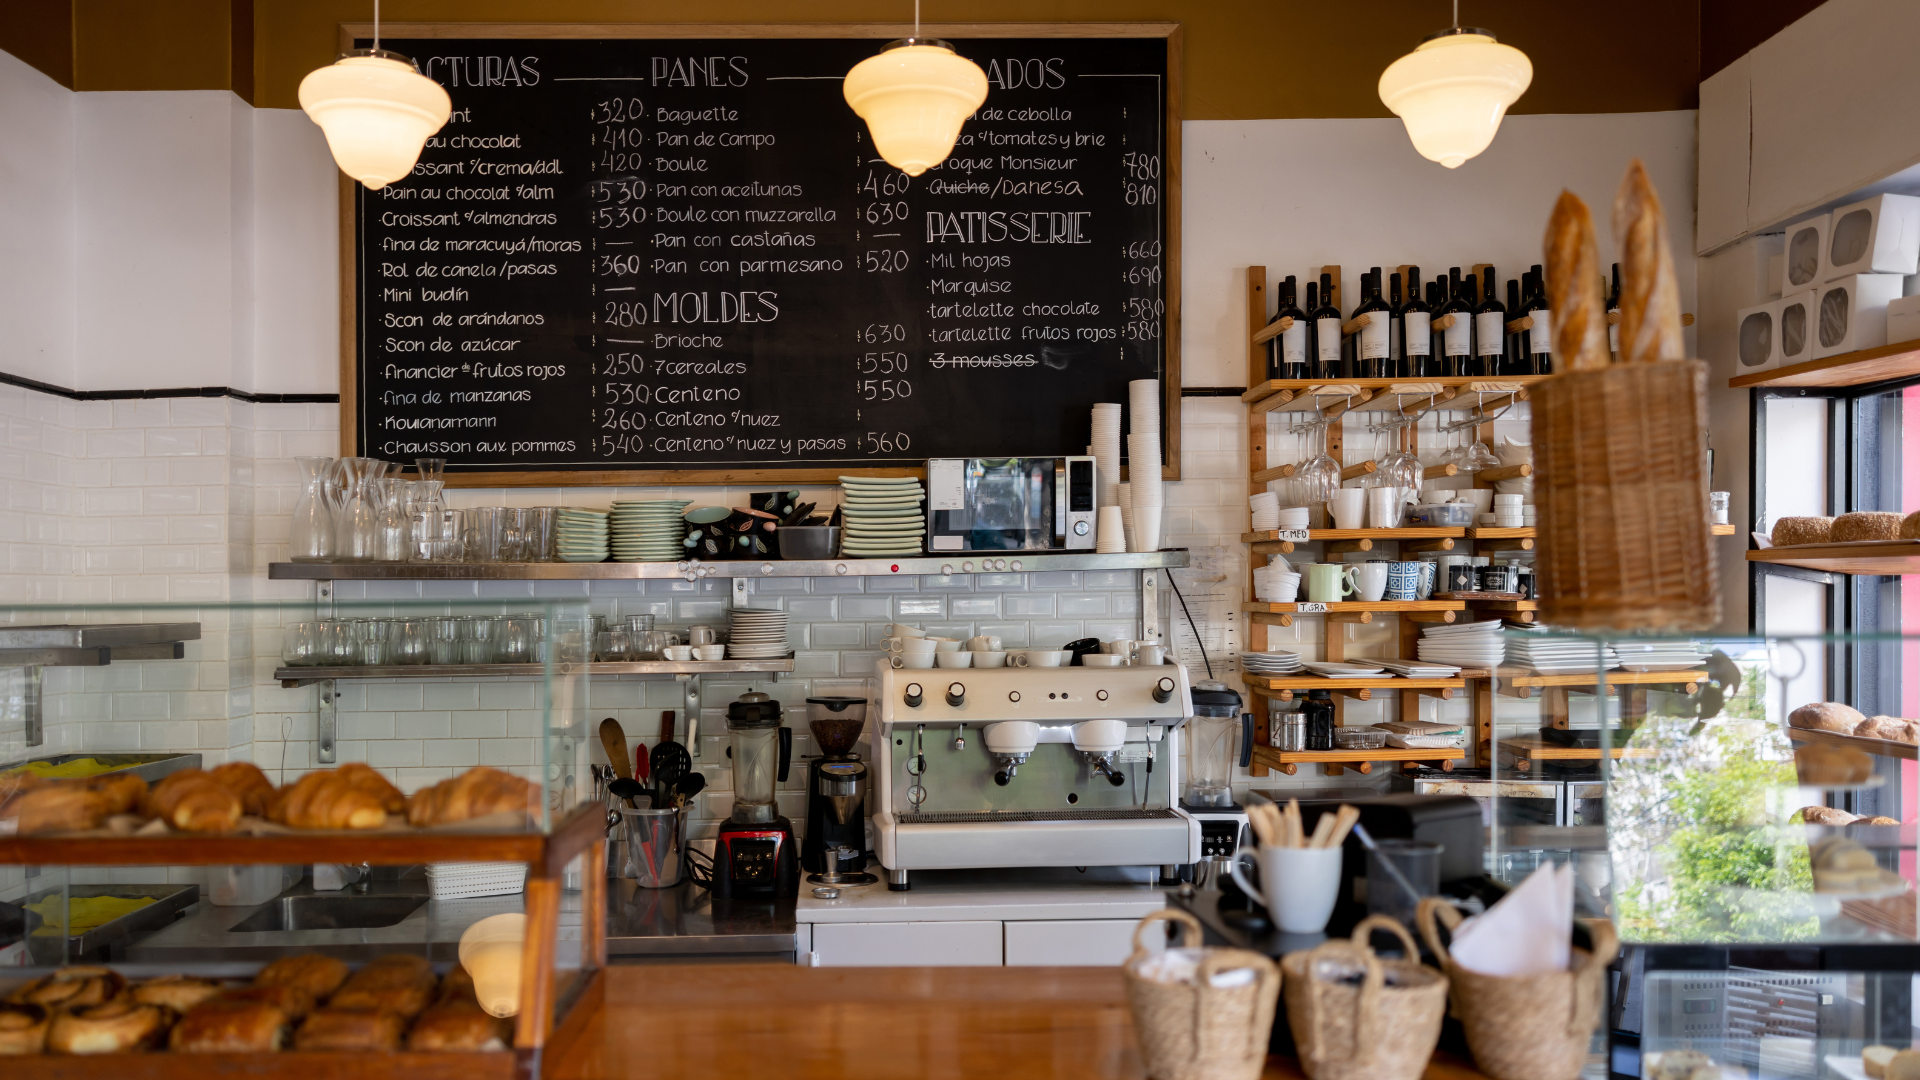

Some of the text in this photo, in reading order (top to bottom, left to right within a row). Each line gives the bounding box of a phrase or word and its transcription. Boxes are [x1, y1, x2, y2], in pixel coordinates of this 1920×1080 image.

[653, 57, 748, 86] PANES
[658, 106, 738, 125] Baguette
[983, 107, 1003, 120] de
[1008, 107, 1071, 121] cebolla
[451, 135, 521, 148] chocolat
[657, 132, 774, 150] Pan de Campo
[1076, 132, 1105, 146] brie
[656, 157, 708, 171] Boule
[1001, 156, 1077, 170] Monsieur
[383, 187, 417, 200] Pain
[421, 189, 440, 199] au
[446, 186, 509, 200] chocolat
[657, 184, 686, 197] Pan
[691, 186, 716, 196] con
[722, 181, 802, 196] aceitunas
[382, 212, 460, 226] Croissant
[657, 206, 707, 222] Boule
[711, 211, 739, 221] con
[746, 207, 835, 222] muzzarella
[927, 212, 1091, 243] PATISSERIE
[383, 237, 415, 251] fina
[420, 237, 439, 251] de
[655, 231, 815, 247] Pan con castañas
[382, 263, 409, 277] Rol
[416, 262, 438, 277] de
[654, 259, 686, 273] Pan
[700, 261, 729, 272] con
[740, 260, 842, 276] parmesano
[932, 253, 1010, 272] Mil hojas
[385, 287, 468, 302] Mini budín
[932, 279, 1011, 297] Marquise
[653, 292, 778, 323] MOLDES
[930, 302, 1014, 318] tartelette
[1023, 301, 1099, 315] chocolate
[385, 313, 423, 327] Scon
[433, 312, 452, 326] de
[459, 312, 544, 325] arándanos
[655, 334, 723, 348] Brioche
[932, 327, 1011, 342] tartelette
[1022, 326, 1069, 339] frutos
[1077, 328, 1116, 342] rojos
[386, 337, 521, 352] Scon de azúcar
[473, 362, 523, 378] frutos
[527, 365, 565, 380] rojos
[384, 391, 416, 405] fina
[422, 390, 442, 404] de
[451, 390, 531, 403] manzanas
[655, 386, 740, 403] Centeno
[656, 411, 725, 426] Centeno
[385, 441, 470, 454] Chausson
[477, 442, 506, 452] aux
[512, 441, 575, 455] pommes
[655, 437, 723, 452] Centeno
[781, 439, 791, 454] y
[798, 439, 846, 455] pasas
